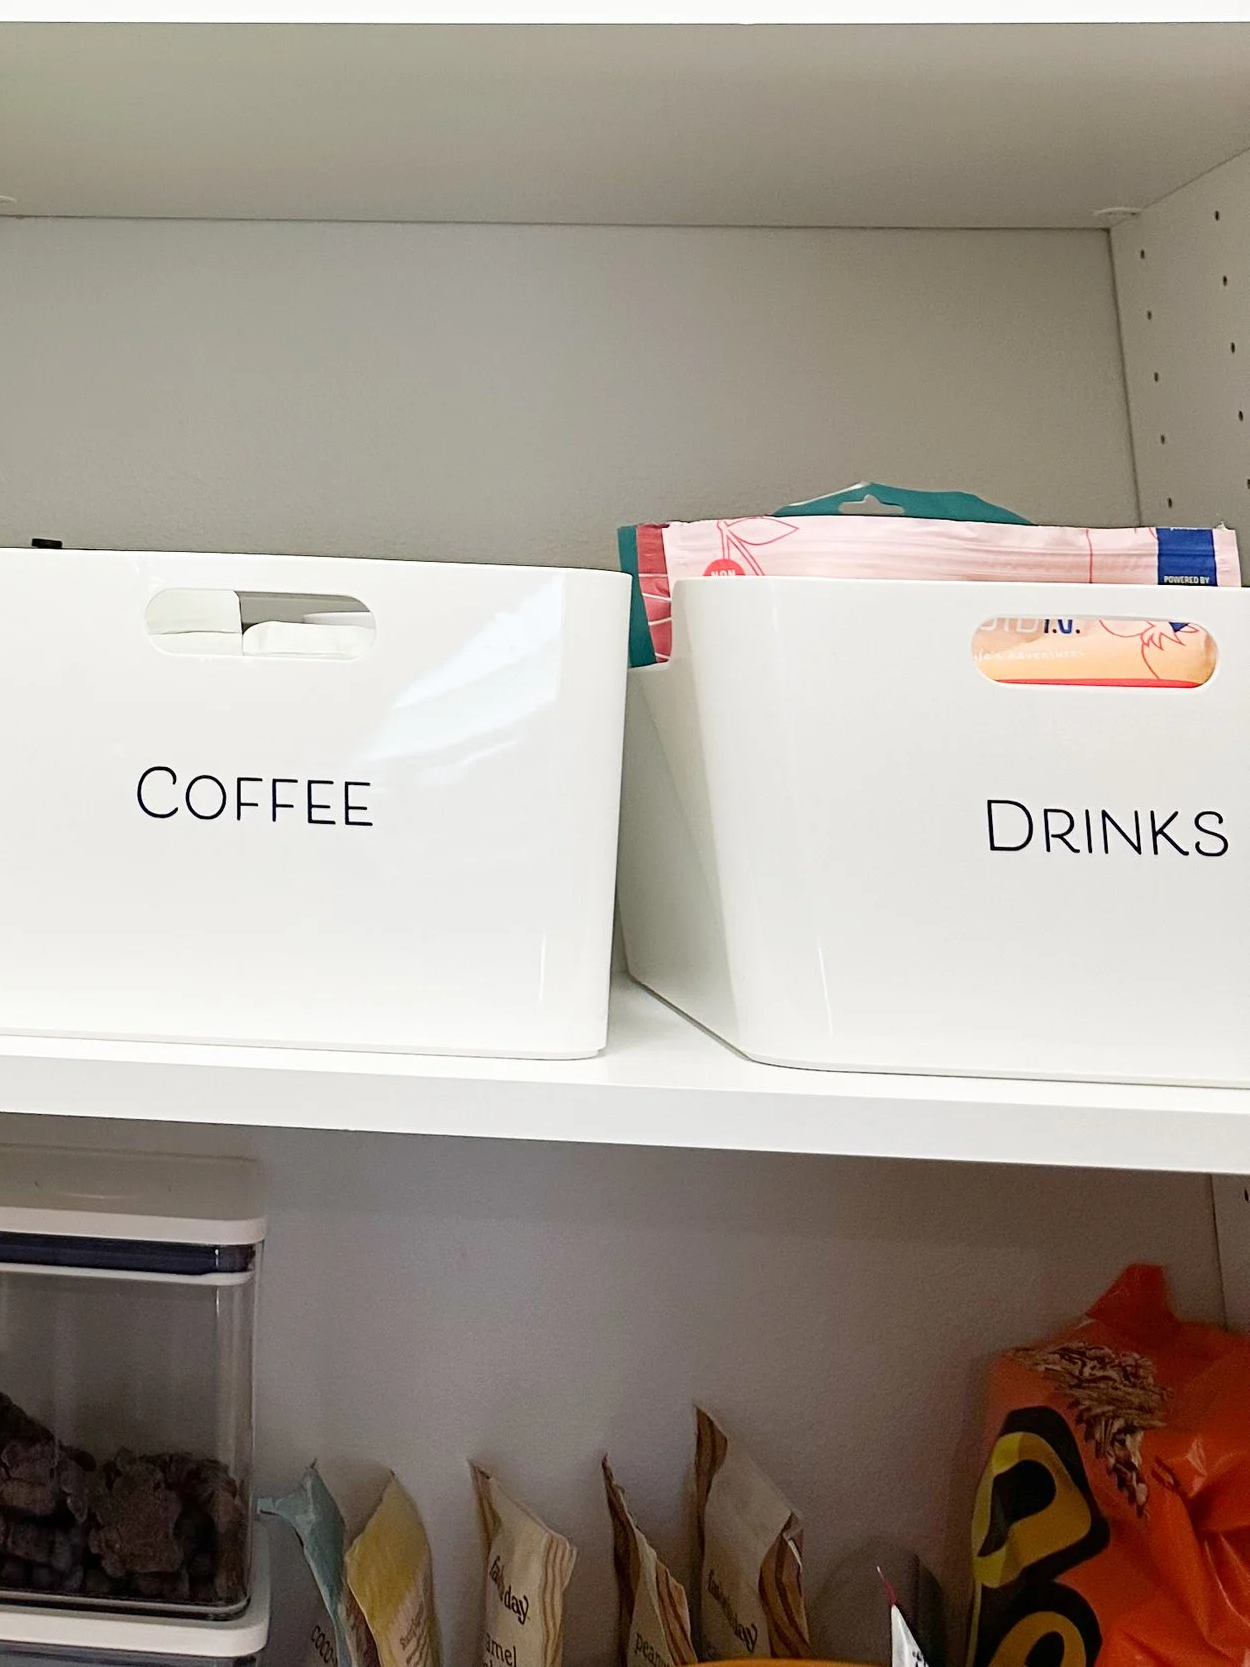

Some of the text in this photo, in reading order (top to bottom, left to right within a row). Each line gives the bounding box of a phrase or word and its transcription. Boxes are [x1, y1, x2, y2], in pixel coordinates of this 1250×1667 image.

[1163, 575, 1210, 584] POWERED BY
[136, 765, 374, 827] COFFEE
[986, 798, 1229, 858] DRINKS
